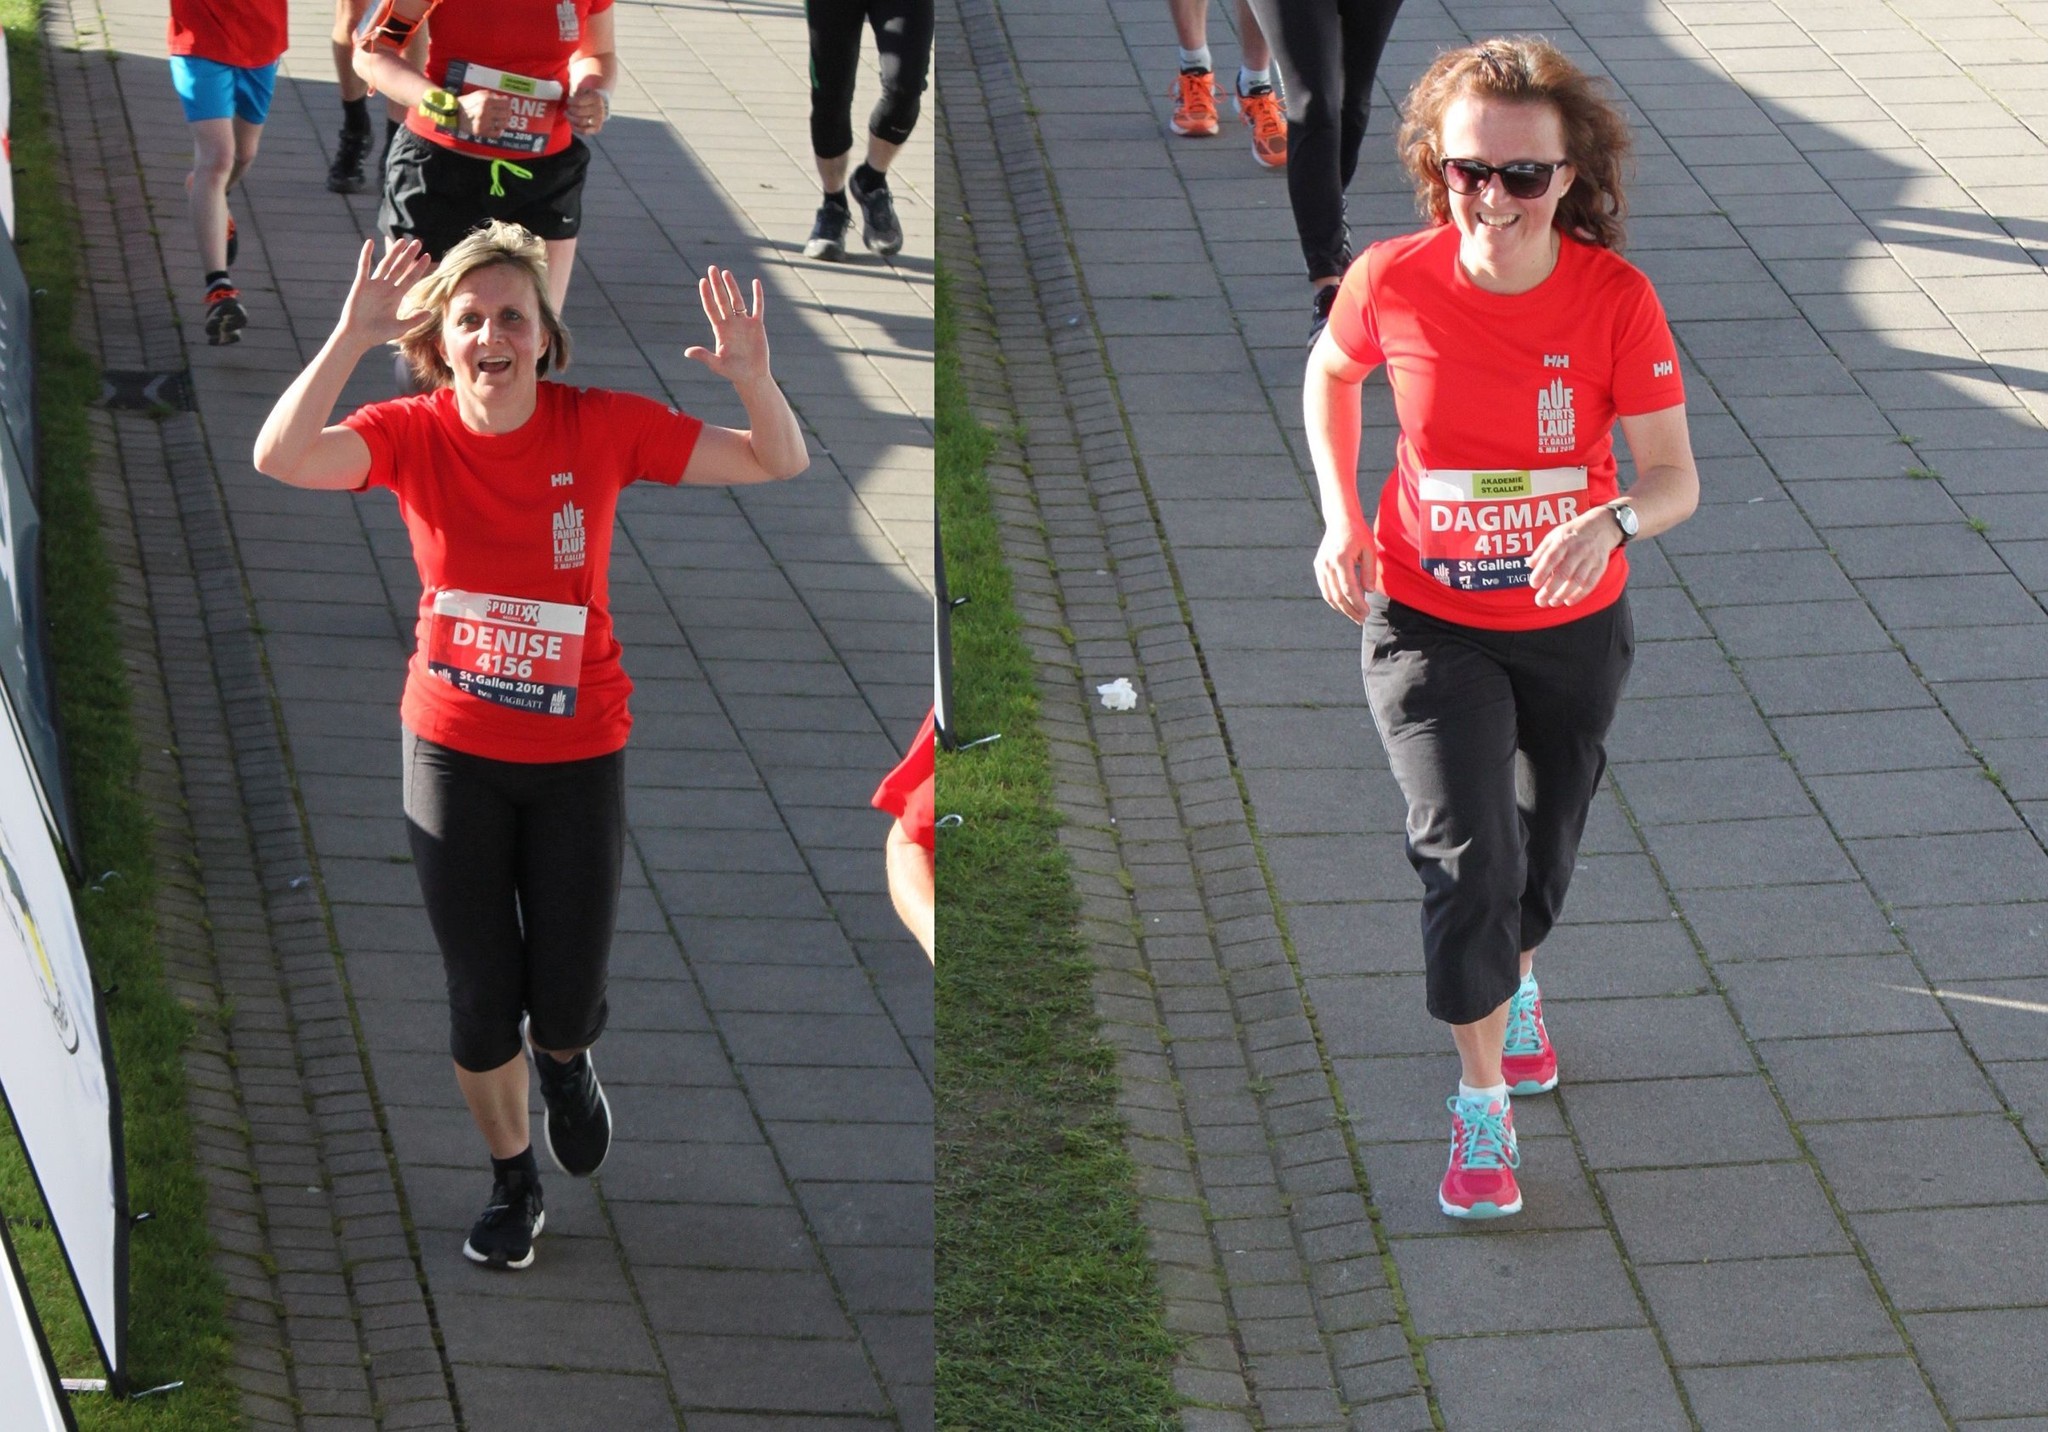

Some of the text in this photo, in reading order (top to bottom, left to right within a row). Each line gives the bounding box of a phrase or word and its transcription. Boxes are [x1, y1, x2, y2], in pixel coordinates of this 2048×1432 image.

[1543, 354, 1569, 368] HH
[1653, 360, 1673, 378] HH
[1538, 376, 1574, 410] AUF
[1538, 408, 1575, 421] FAHRTS
[1538, 419, 1575, 437] LAUF
[550, 472, 574, 487] HH
[1481, 476, 1523, 485] AKADEMIE
[552, 500, 584, 530] AUF
[1430, 496, 1578, 532] DAGMAR
[552, 527, 585, 540] FAHRTS
[553, 538, 586, 555] LAUF
[1474, 531, 1534, 555] 4151
[1458, 560, 1476, 572] St.
[1478, 559, 1521, 572] Gallen
[452, 622, 563, 660] DENISE
[475, 652, 533, 678] 4156
[459, 670, 475, 682] St.
[476, 674, 514, 691] Gallen
[515, 682, 545, 695] 2016
[498, 694, 544, 709] TAGBLATT
